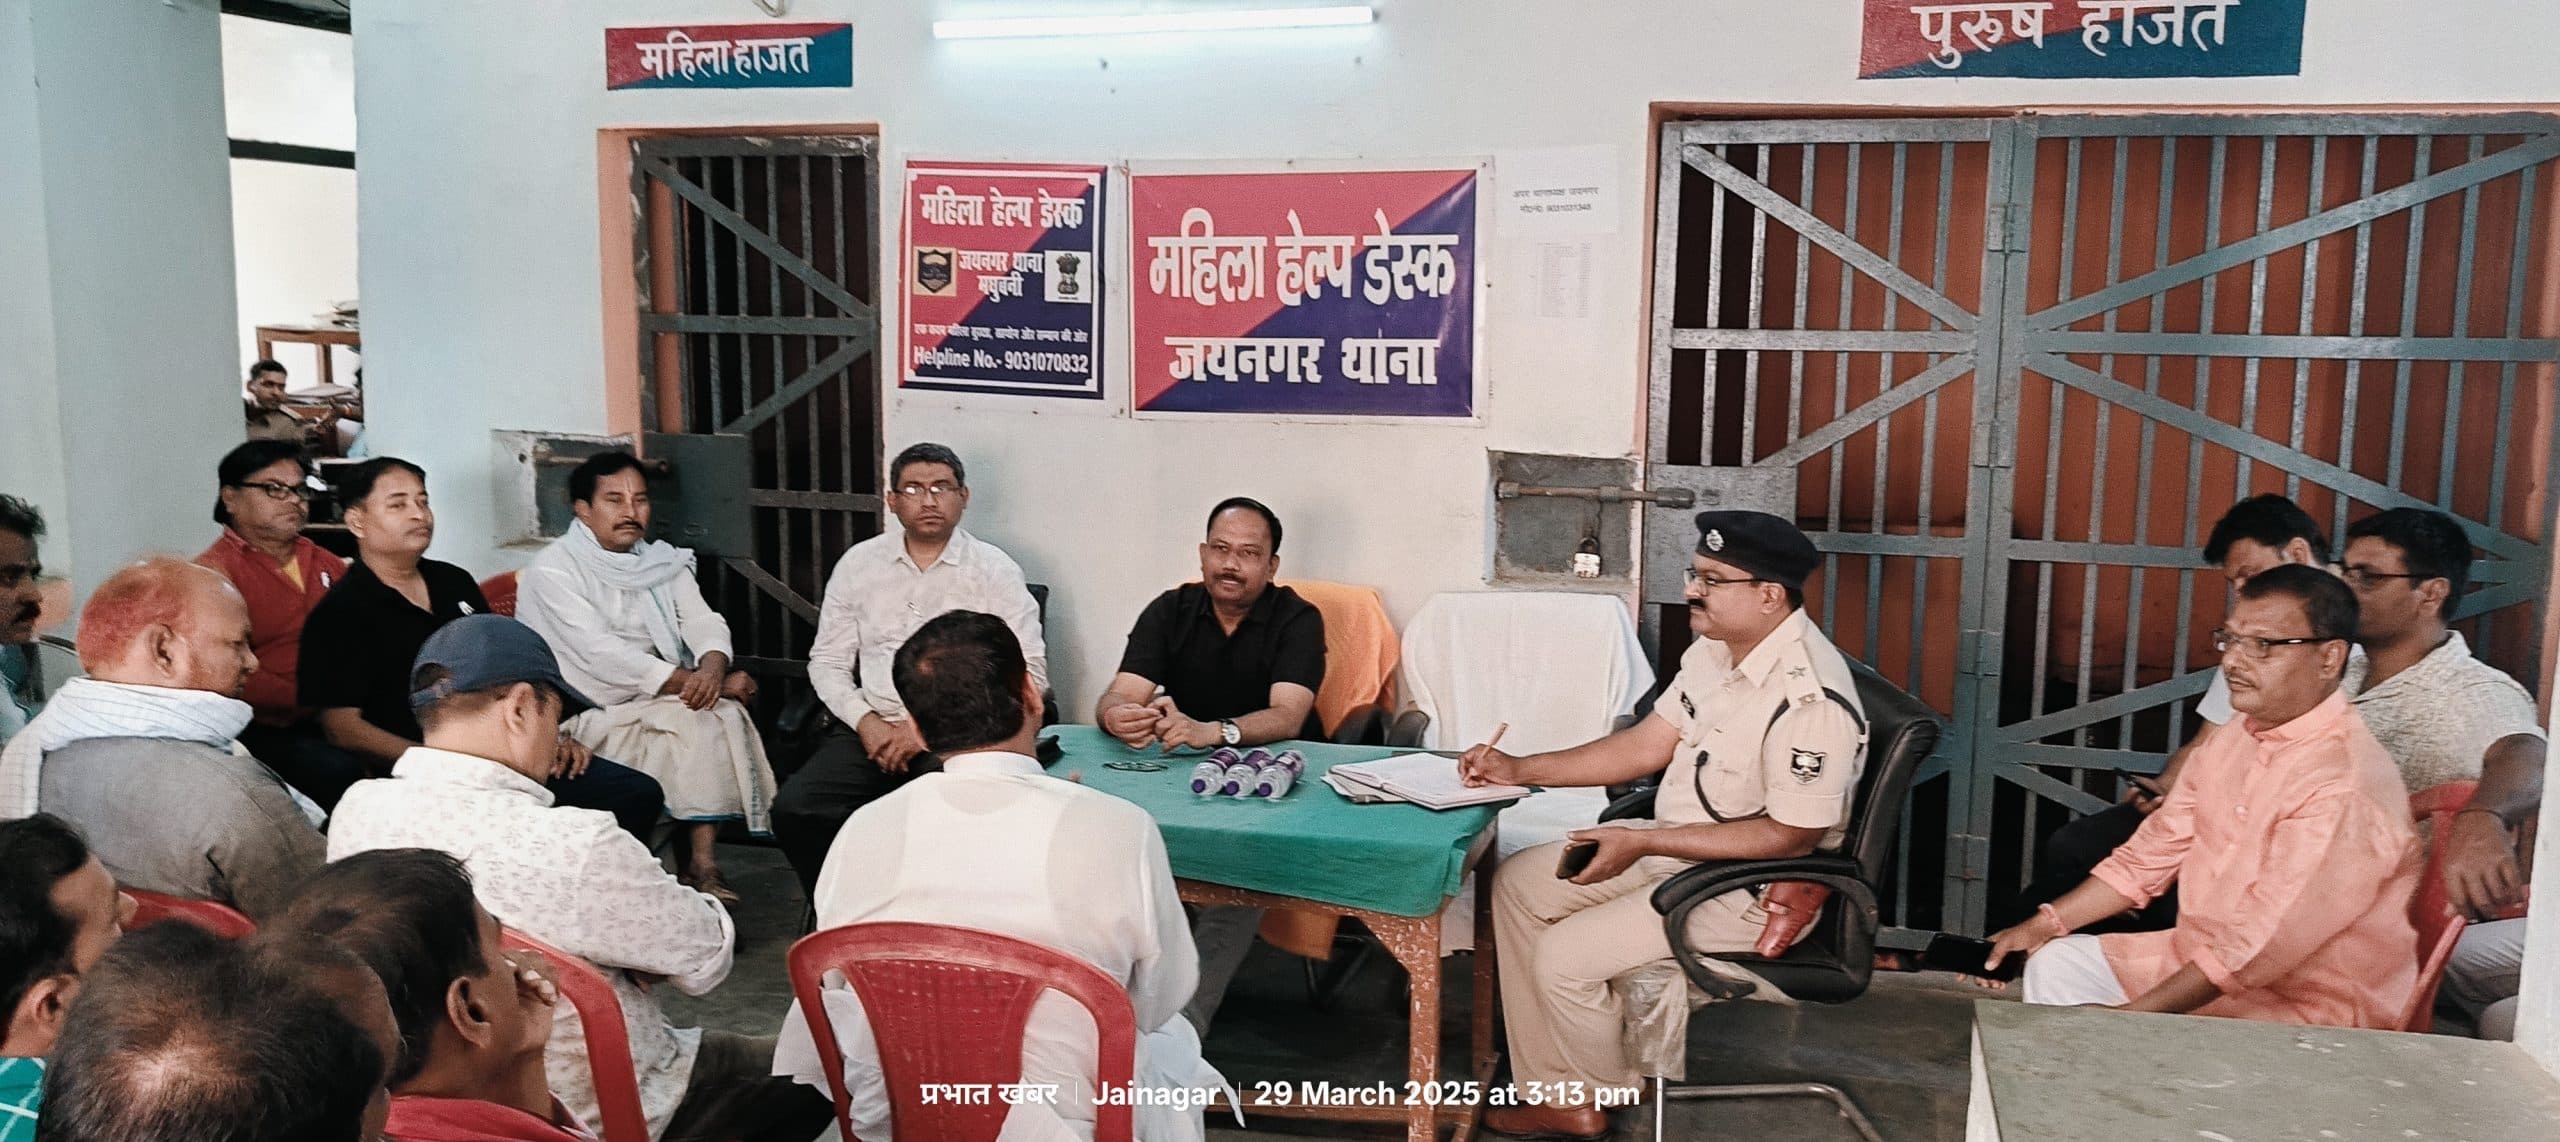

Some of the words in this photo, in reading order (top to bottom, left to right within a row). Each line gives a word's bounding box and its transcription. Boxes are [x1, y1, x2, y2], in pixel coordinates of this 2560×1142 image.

[2077, 0, 2240, 57] हाजत
[636, 30, 732, 82] महिला
[733, 36, 815, 79] हाजत
[919, 185, 986, 227] महिला
[989, 186, 1034, 228] हेल्प
[1037, 188, 1086, 230] डेस्क
[957, 250, 1009, 272] जयनगर
[1012, 252, 1044, 273] थाना
[1147, 207, 1268, 306] महिला
[1275, 208, 1356, 306] हेल्प
[1362, 207, 1460, 305] डेस्क
[976, 270, 1024, 303] मधुबनी
[914, 345, 971, 370] Helpline
[1004, 350, 1089, 374] 9031070832
[1163, 336, 1325, 384] जयनगर
[1341, 336, 1441, 385] थाना
